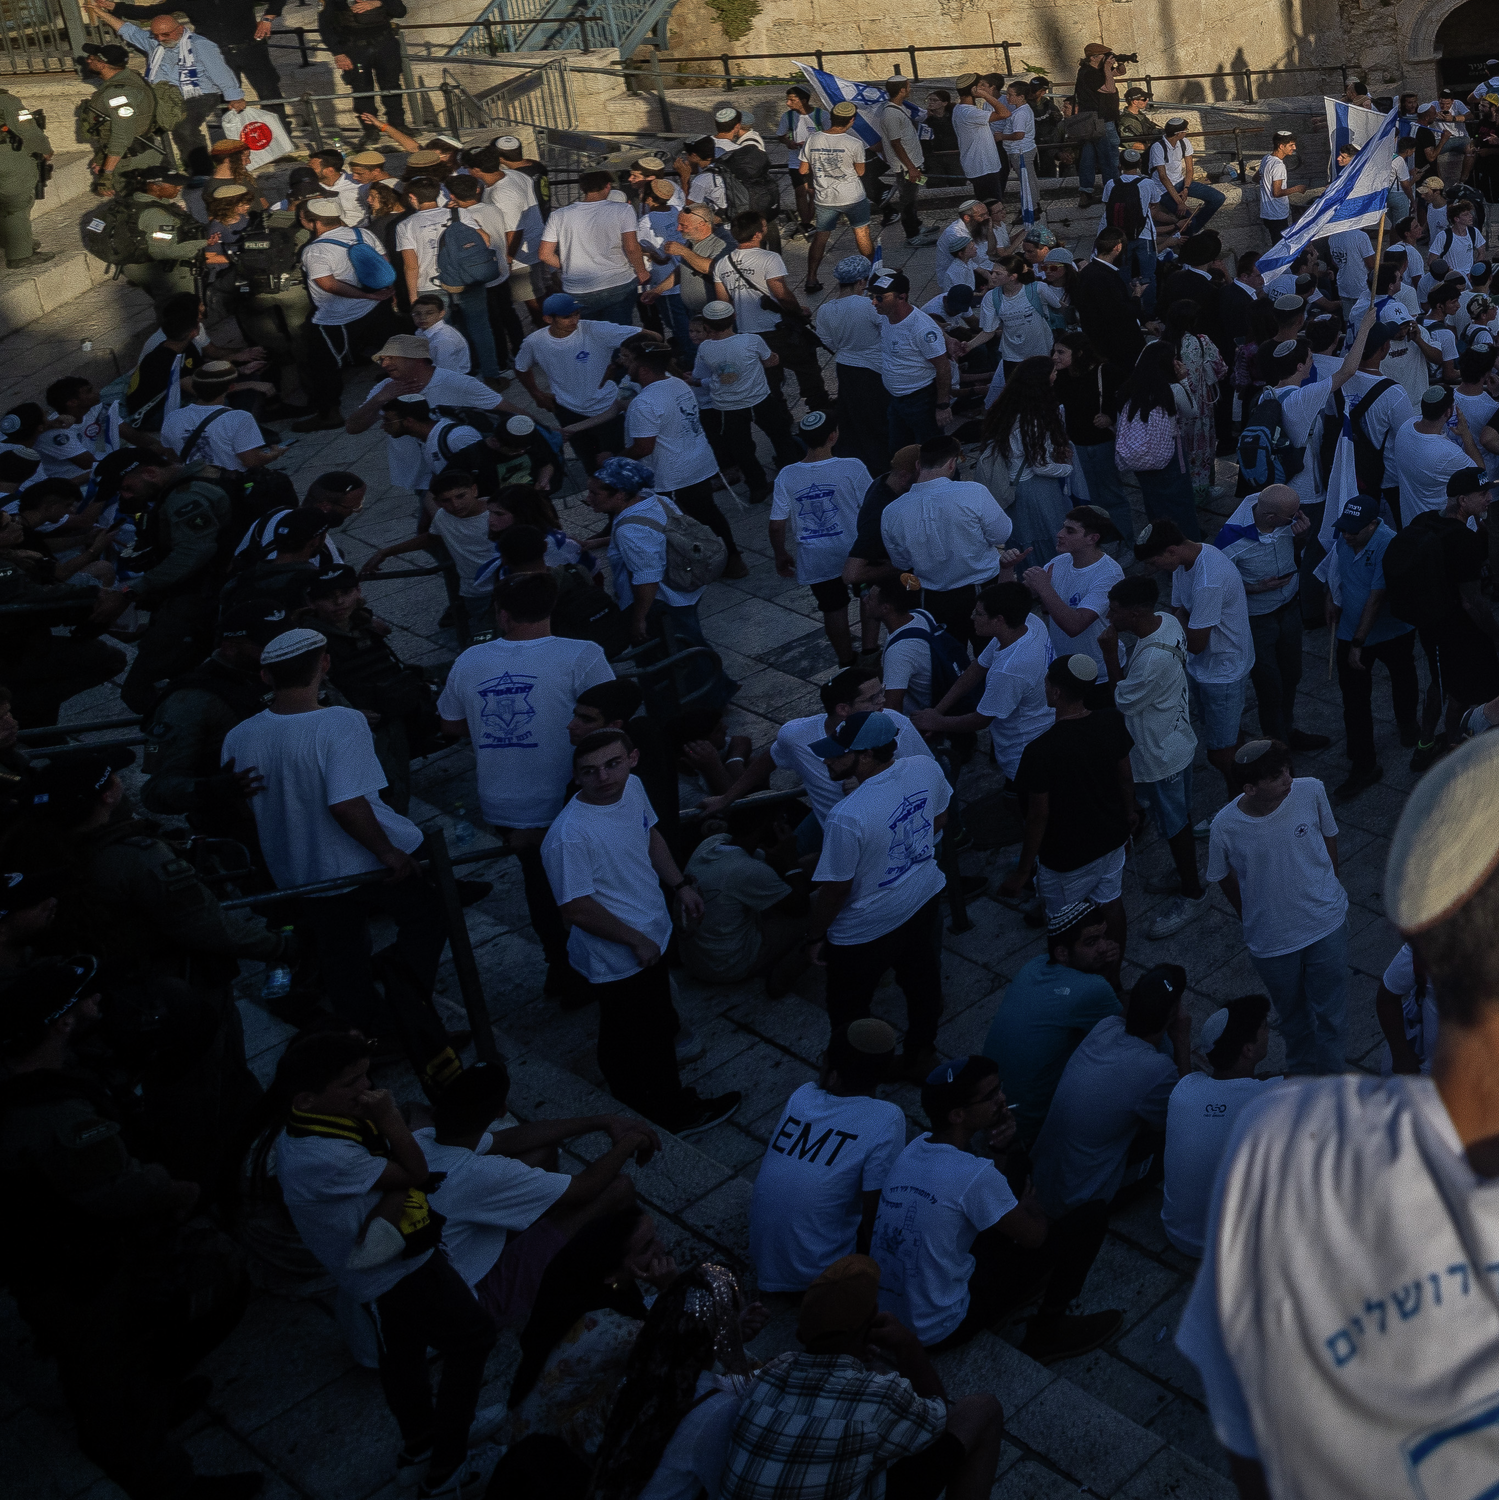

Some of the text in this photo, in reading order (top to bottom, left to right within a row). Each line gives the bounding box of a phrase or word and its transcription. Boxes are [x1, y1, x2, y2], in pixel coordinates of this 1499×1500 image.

[223, 630, 247, 638] POLICE
[771, 1115, 860, 1167] EMT
[1325, 1263, 1472, 1367] רושלים
